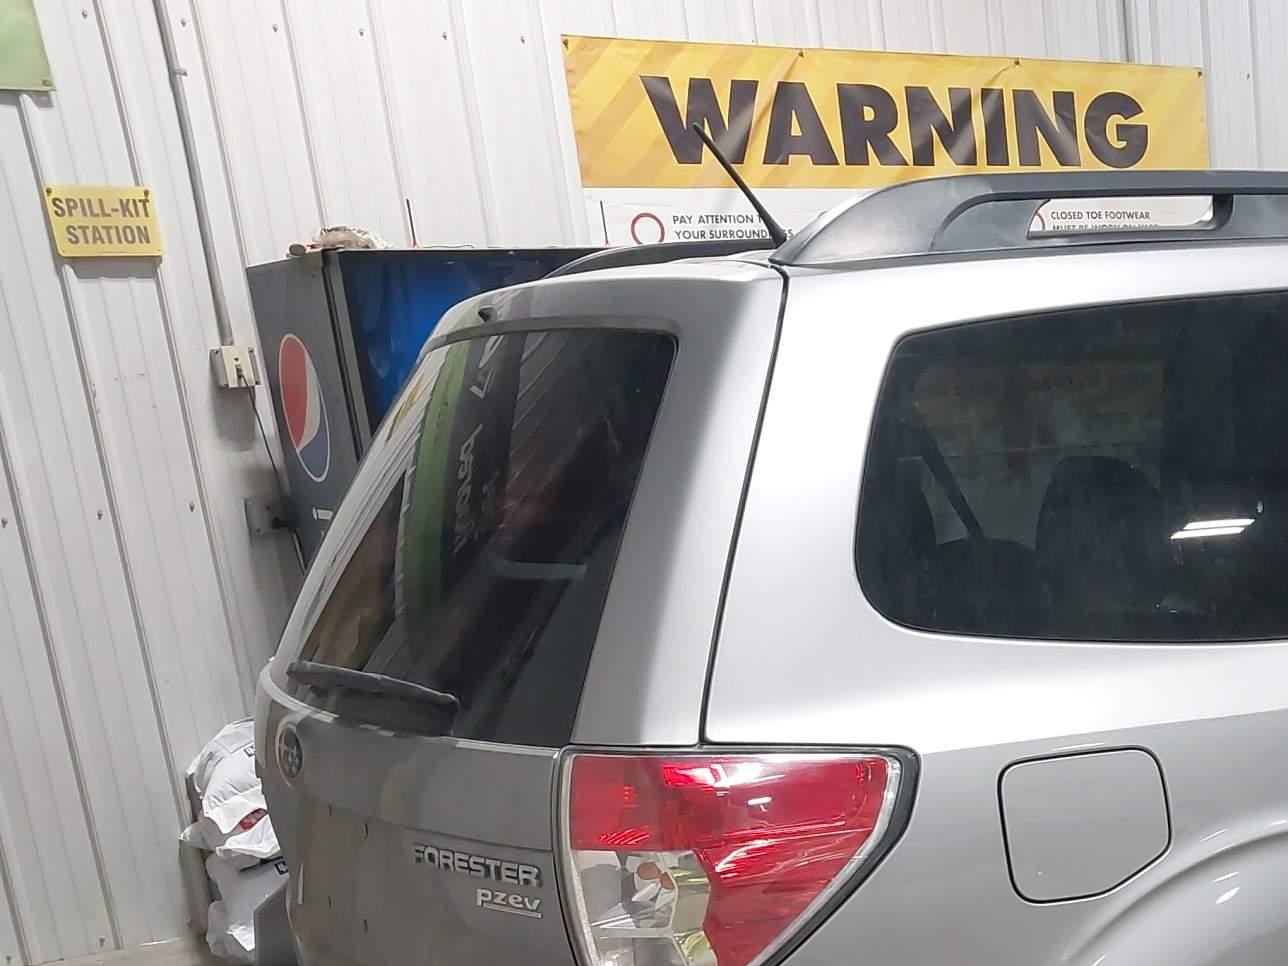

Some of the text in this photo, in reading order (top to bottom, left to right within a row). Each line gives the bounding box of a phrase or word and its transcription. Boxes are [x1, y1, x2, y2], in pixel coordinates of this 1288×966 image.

[639, 75, 1149, 169] WARNING
[51, 197, 150, 218] SPILL-KIT
[1050, 210, 1151, 220] CLOSED TOE FOOTWEAR
[672, 215, 692, 225] PAY
[698, 214, 754, 224] ATTENTION
[66, 224, 151, 245] STATION
[675, 229, 706, 240] YOUR
[413, 844, 543, 888] FORESTER
